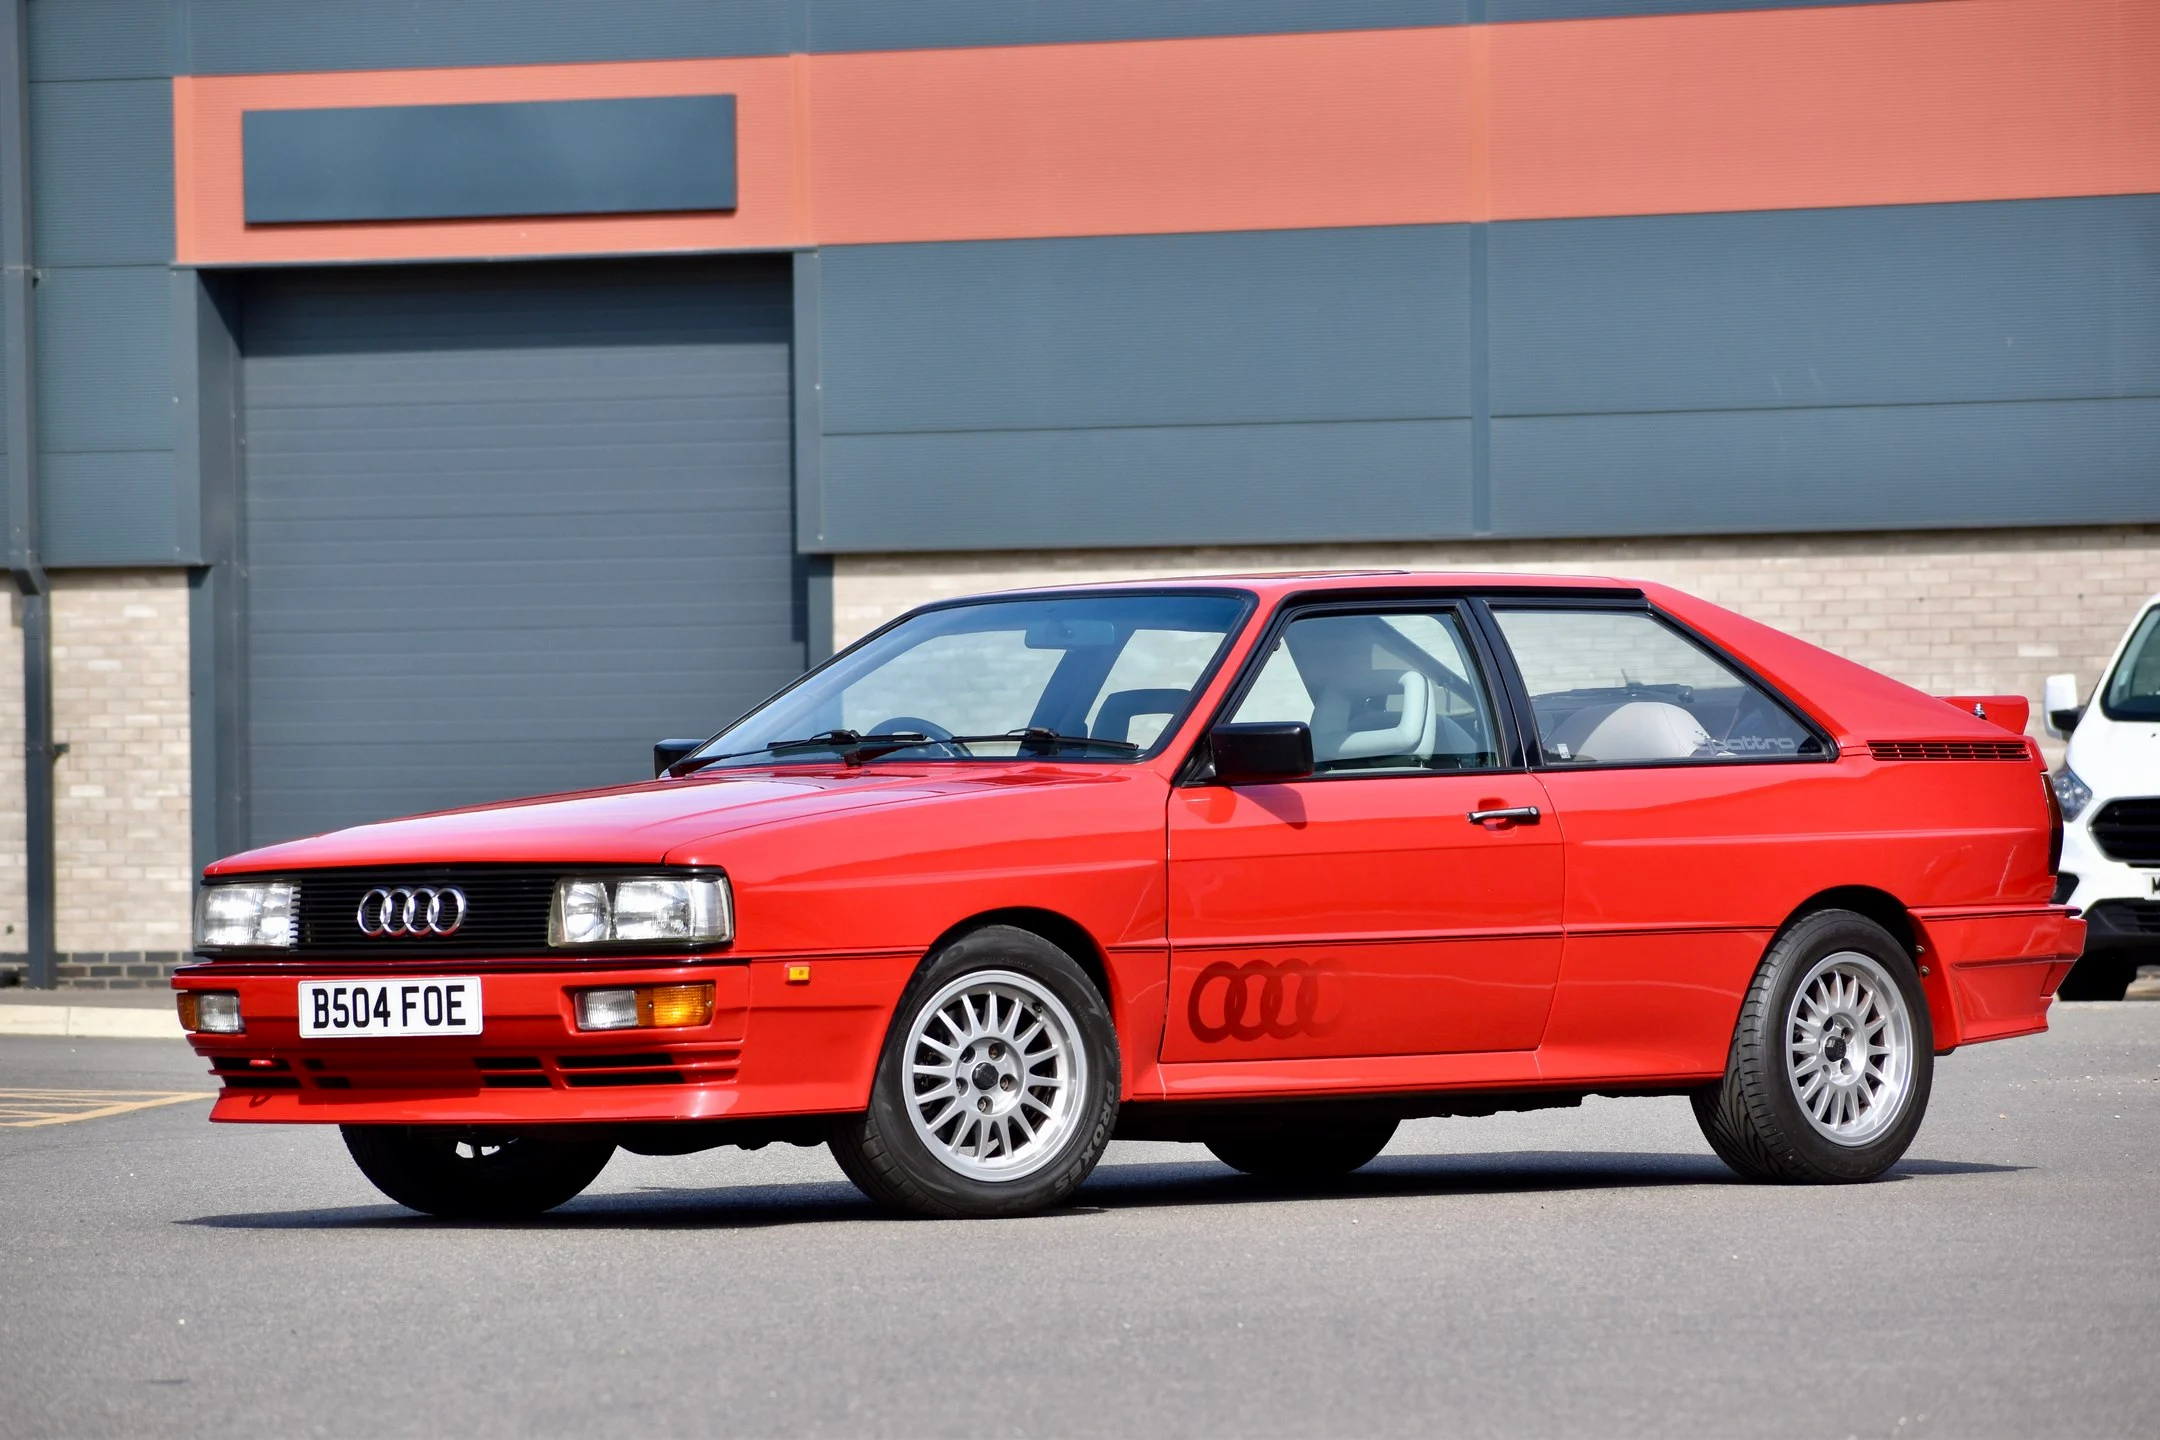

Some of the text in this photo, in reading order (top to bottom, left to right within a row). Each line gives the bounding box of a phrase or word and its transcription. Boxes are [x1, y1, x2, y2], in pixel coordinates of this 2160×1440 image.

[312, 985, 466, 1029] B504 FOE
[1054, 1079, 1116, 1194] PROXES
